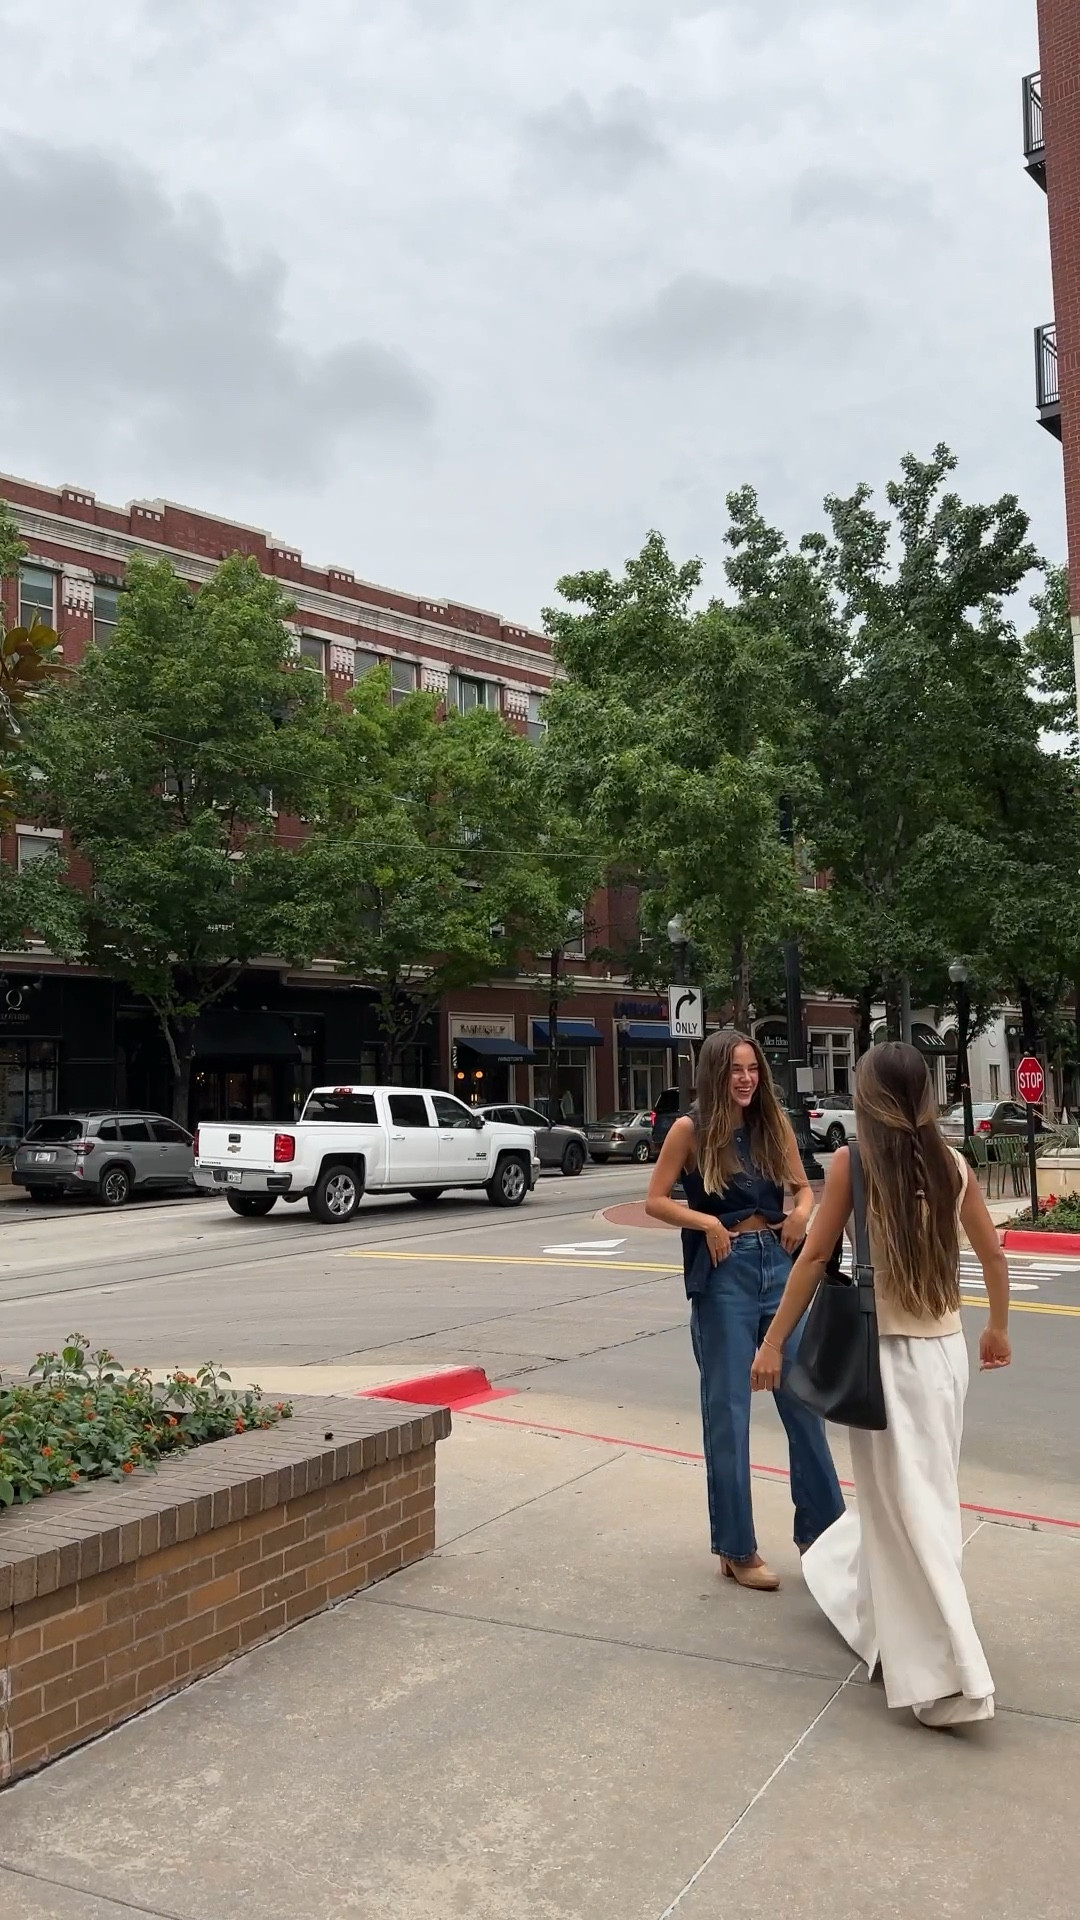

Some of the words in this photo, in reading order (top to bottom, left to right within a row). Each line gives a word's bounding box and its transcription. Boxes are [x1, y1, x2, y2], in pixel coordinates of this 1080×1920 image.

[6, 989, 22, 1011] Q
[675, 1022, 699, 1034] ONLY
[918, 1035, 946, 1045] VICI
[1019, 1072, 1042, 1088] STOP
